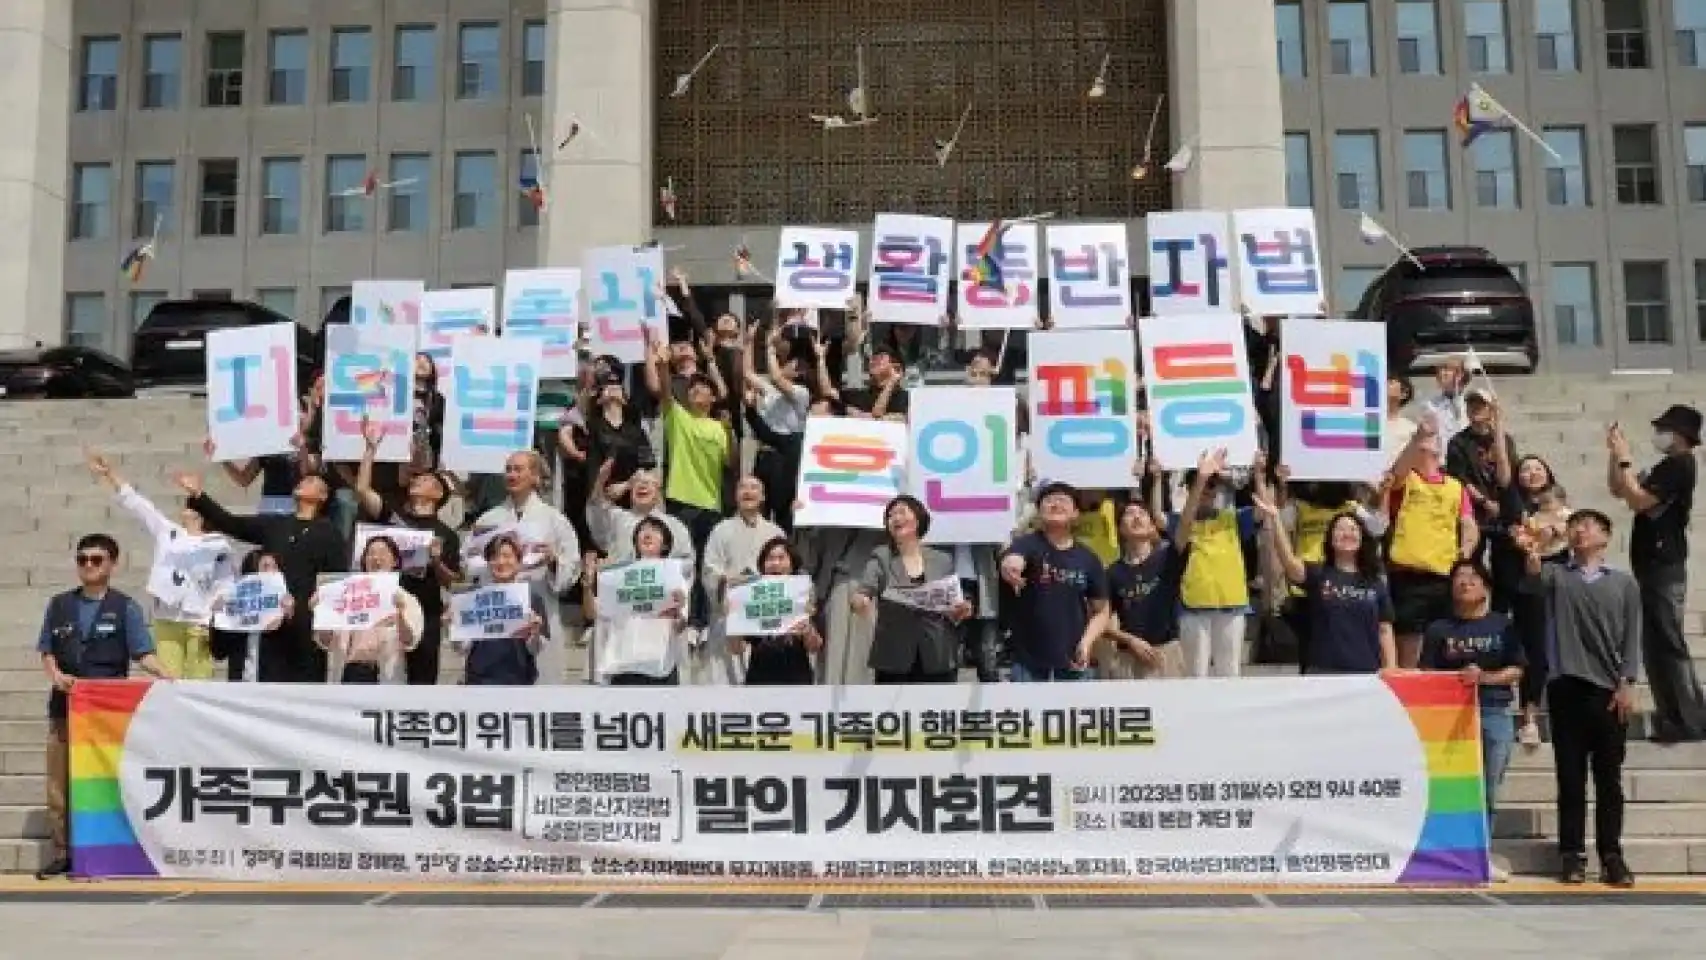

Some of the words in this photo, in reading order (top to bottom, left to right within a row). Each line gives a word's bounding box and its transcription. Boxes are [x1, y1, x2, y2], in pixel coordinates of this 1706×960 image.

[782, 240, 853, 293] 생
[874, 234, 948, 304] 활
[1050, 242, 1126, 308] 반
[1152, 233, 1228, 306] 자
[1240, 228, 1322, 295] 법
[213, 345, 293, 428] 지
[452, 361, 536, 449] 법
[1036, 358, 1130, 459] 평
[1151, 343, 1246, 438] 등
[1286, 352, 1382, 452] 법
[803, 434, 901, 506] 혼
[917, 414, 1011, 513] 인
[361, 709, 466, 749] 가족의
[475, 711, 584, 751] 위기를
[593, 711, 665, 752] 넘어
[681, 710, 794, 752] 새로운
[800, 711, 912, 752] 가족의
[920, 708, 1034, 750] 행복한
[1042, 706, 1155, 748] 미래로
[143, 766, 413, 827] 가족구성권
[425, 772, 516, 831] 3법
[533, 794, 671, 818] 비혼출산지원법
[554, 771, 651, 793] 혼인평등법
[693, 775, 808, 835] 발의
[823, 773, 1055, 834] 기자회견
[1118, 784, 1182, 802] 2023년
[1186, 782, 1215, 801] 5월
[1219, 781, 1285, 801] 31일(수)
[1288, 779, 1322, 799] 오전
[1325, 779, 1355, 798] 9시
[1358, 778, 1402, 798] 40분
[288, 849, 353, 870] 국회의원
[541, 819, 662, 843] 생활동반자법
